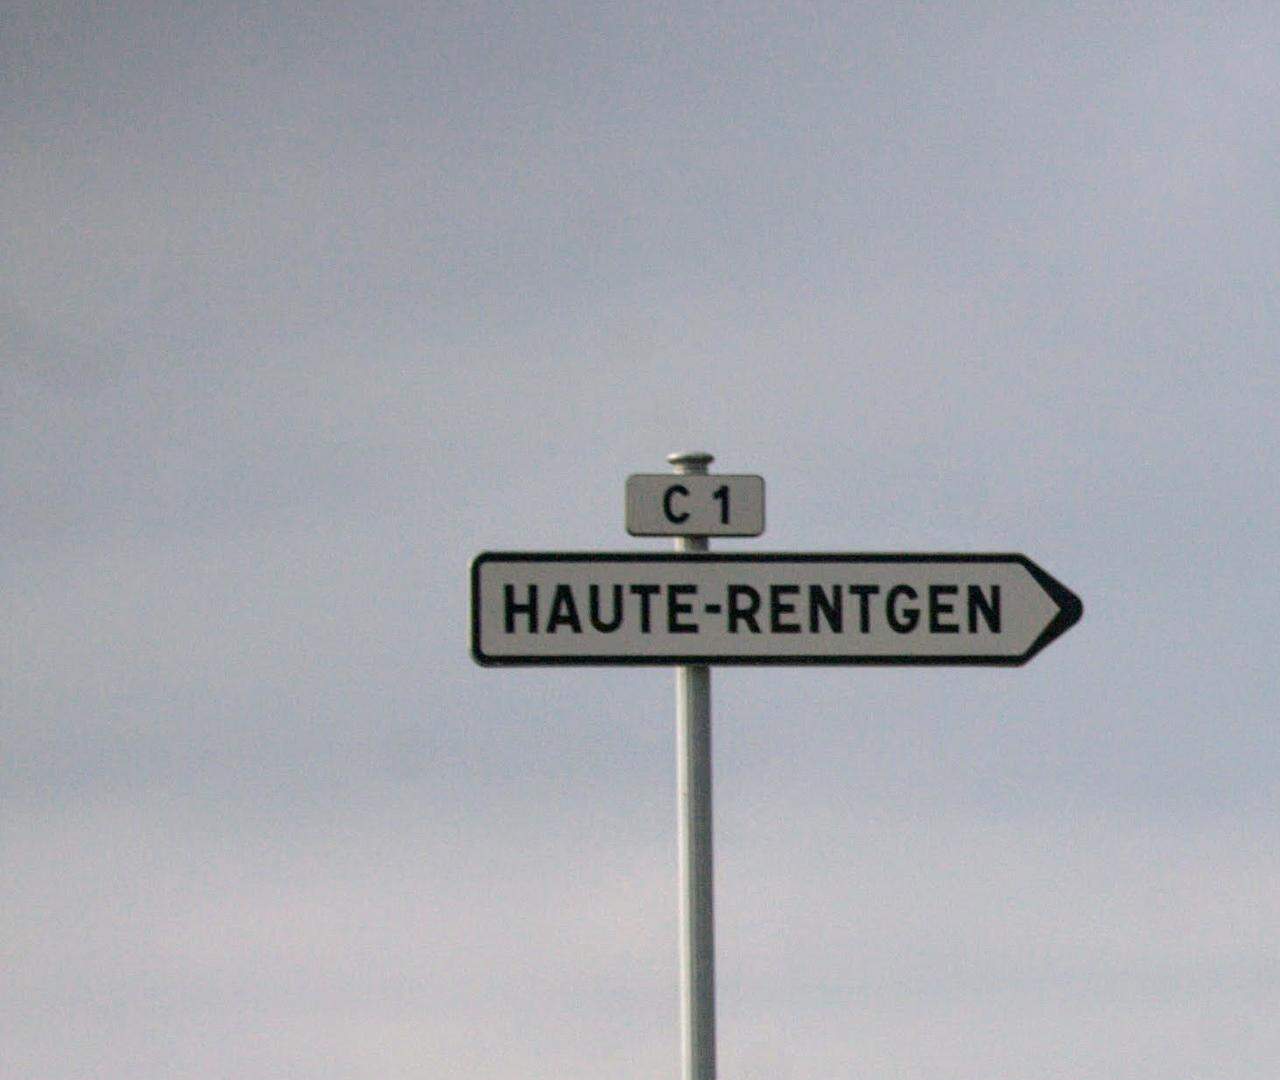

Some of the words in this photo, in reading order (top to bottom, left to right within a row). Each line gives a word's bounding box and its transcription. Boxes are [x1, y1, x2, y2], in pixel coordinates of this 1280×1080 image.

[663, 484, 690, 525] C
[713, 485, 730, 525] 1
[503, 583, 1001, 635] HAUTE-RENTGEN
